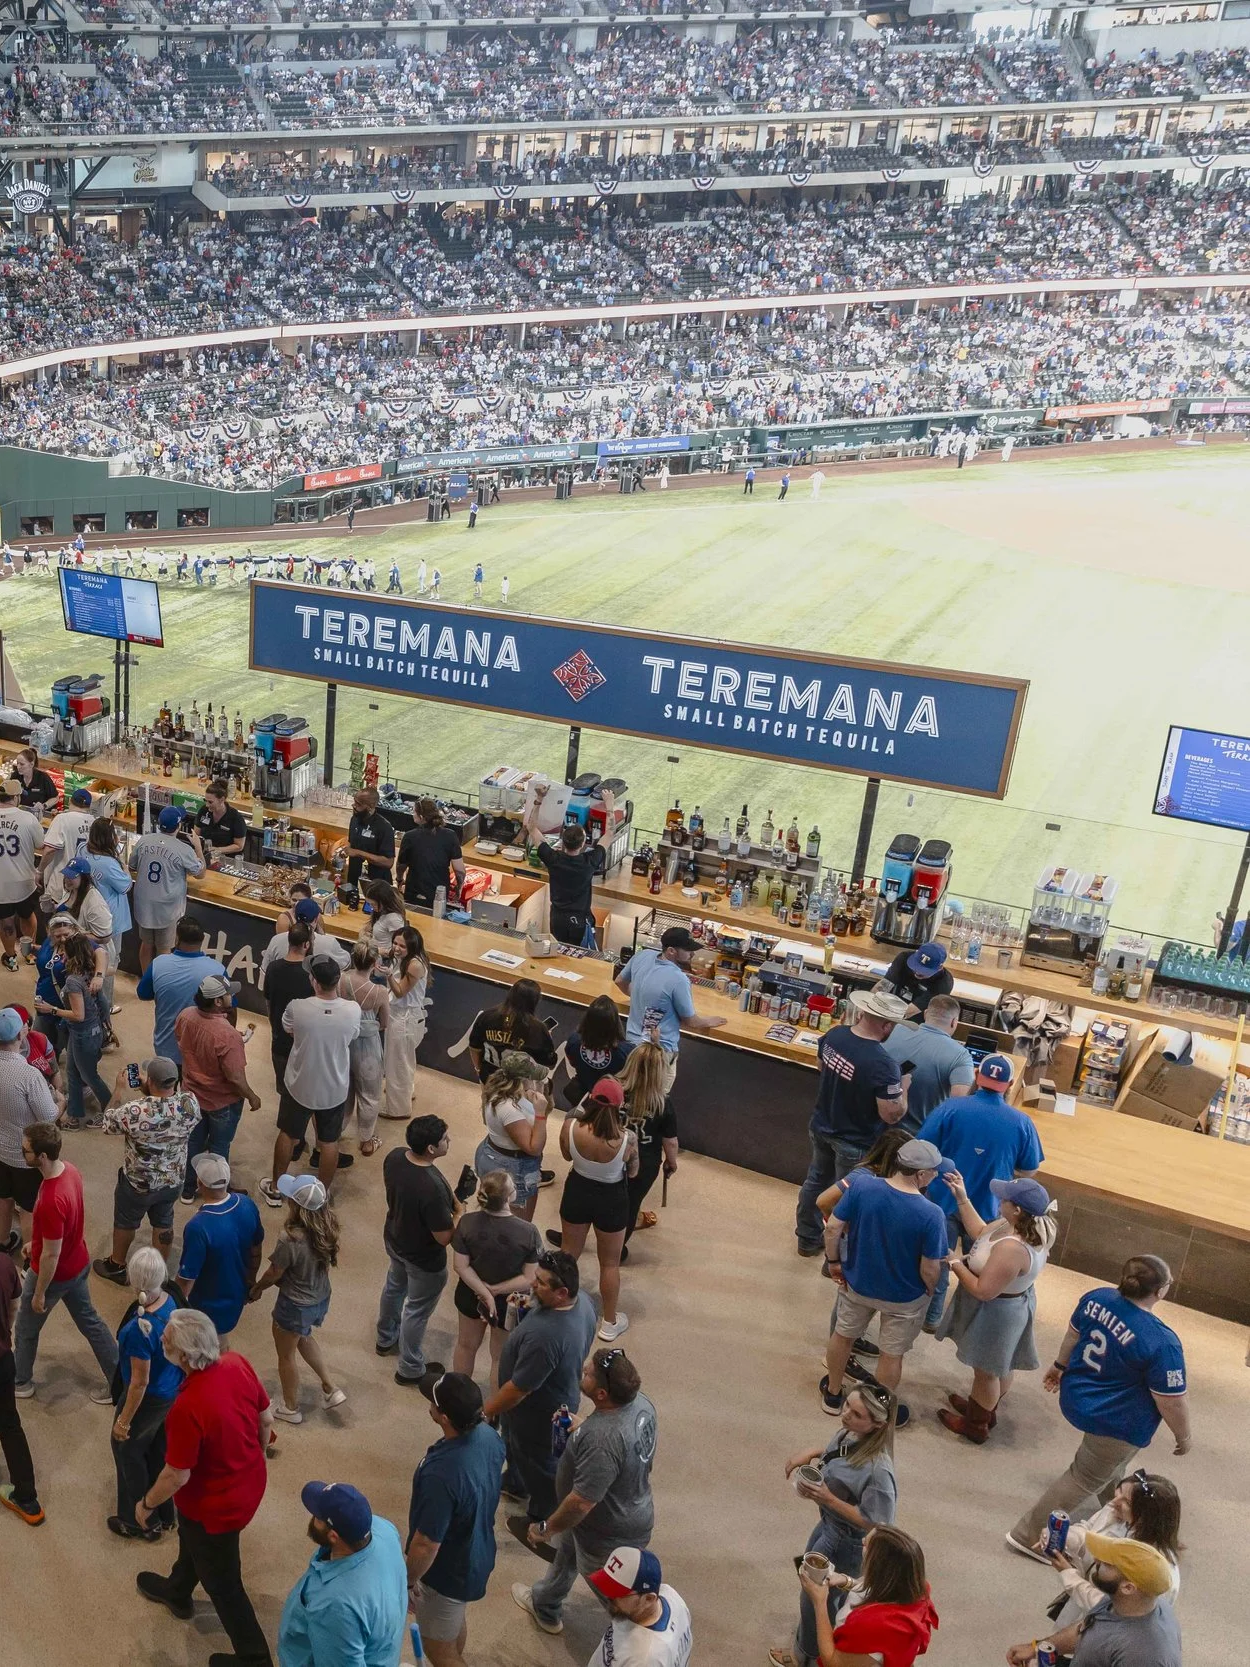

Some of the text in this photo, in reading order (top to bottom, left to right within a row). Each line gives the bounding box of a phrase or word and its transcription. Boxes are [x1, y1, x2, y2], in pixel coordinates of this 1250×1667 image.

[4, 182, 24, 199] JACK
[438, 456, 472, 467] American
[486, 453, 521, 463] American
[534, 449, 567, 459] American
[398, 461, 424, 472] American
[295, 605, 520, 673] TEREMANA
[314, 647, 489, 689] SMALL BATCH TEQUILA
[642, 655, 940, 738] TEREMANA
[664, 703, 896, 756] SMALL BATCH TEQUILA
[1184, 754, 1213, 763] BEVERAGES
[147, 861, 162, 883] 8
[920, 953, 931, 965] T
[990, 1064, 1002, 1079] T
[1084, 1300, 1136, 1345] SEMIEN
[1083, 1329, 1107, 1372] 2
[607, 1555, 623, 1574] T
